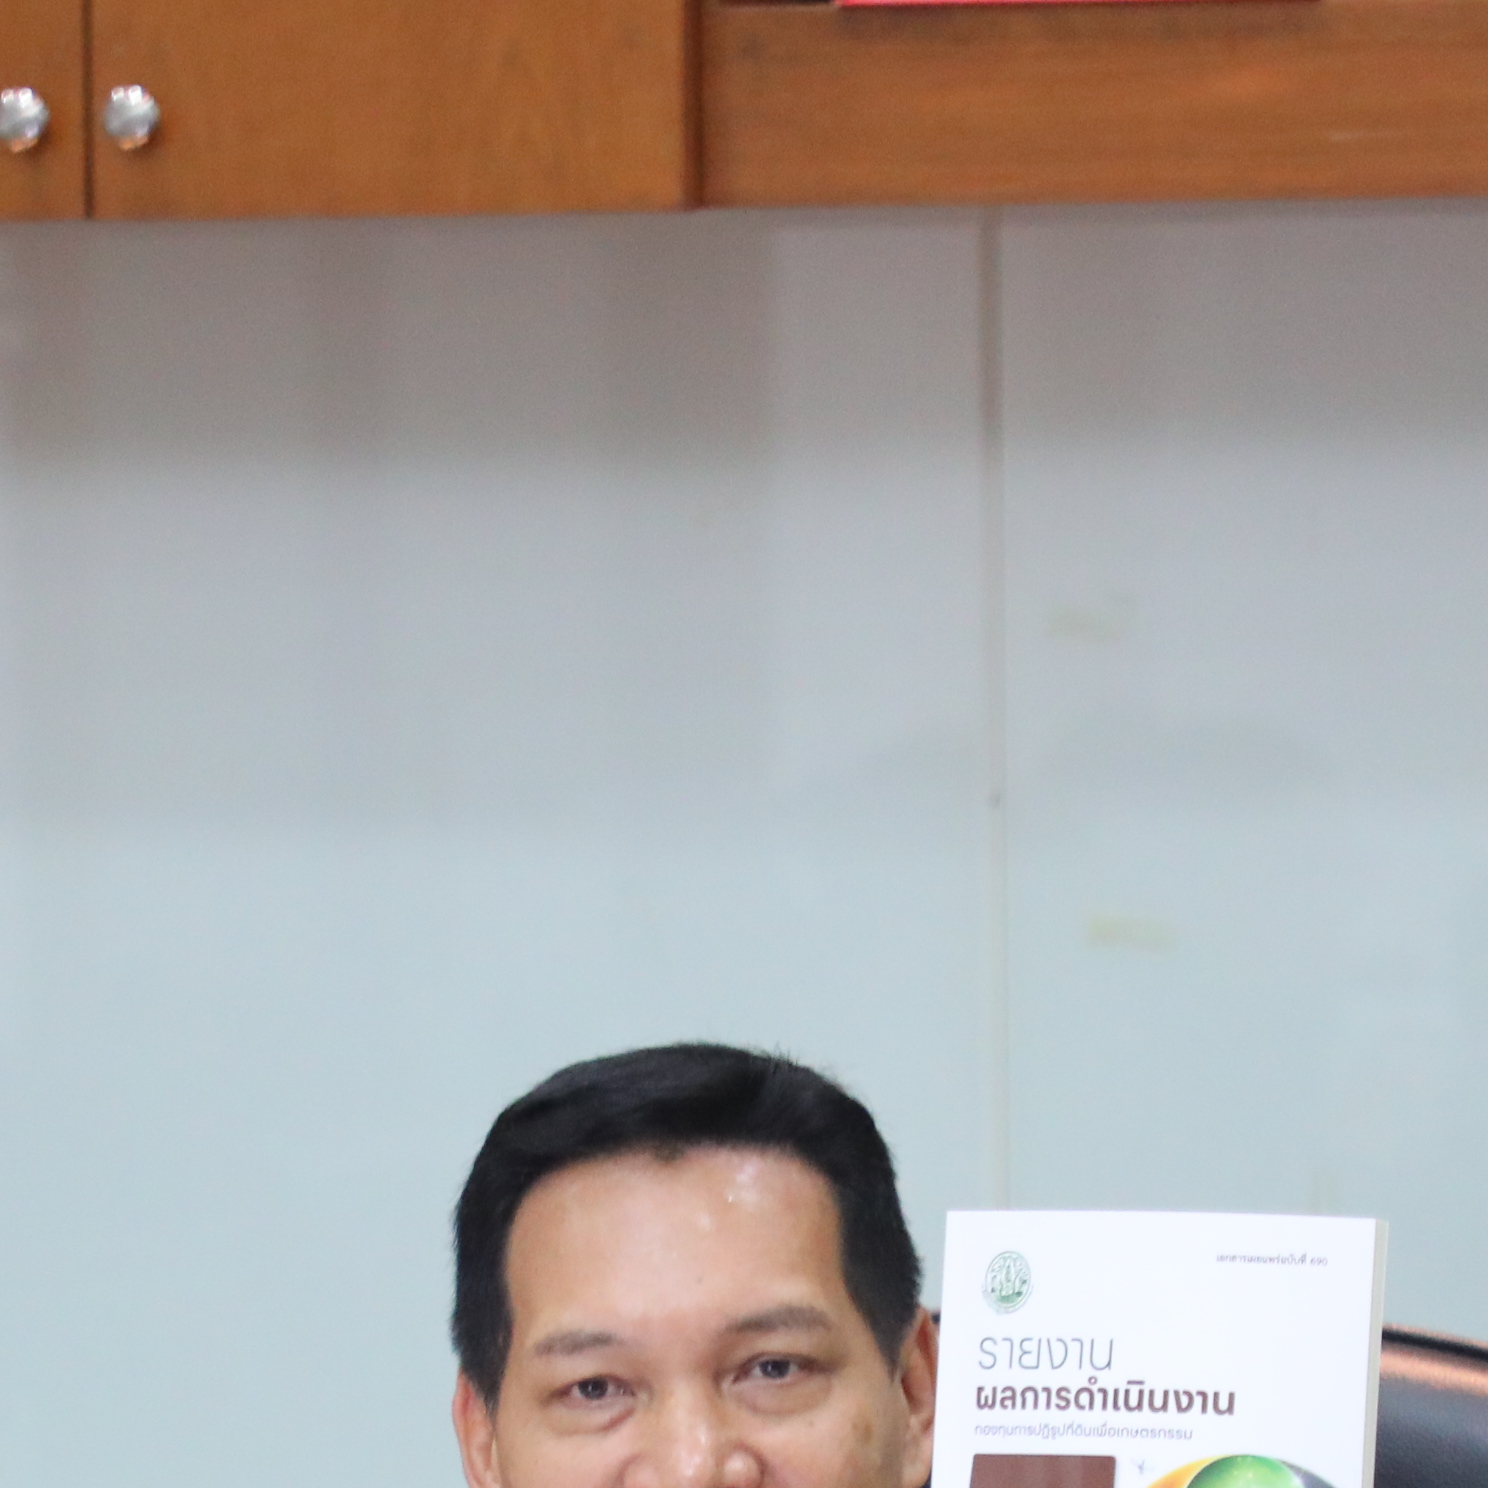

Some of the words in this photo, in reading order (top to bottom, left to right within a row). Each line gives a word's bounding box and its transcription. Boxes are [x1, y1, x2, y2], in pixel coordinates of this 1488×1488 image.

[978, 1336, 1114, 1371] รายงาน
[975, 1375, 1236, 1416] ผลการดำเนินงาน
